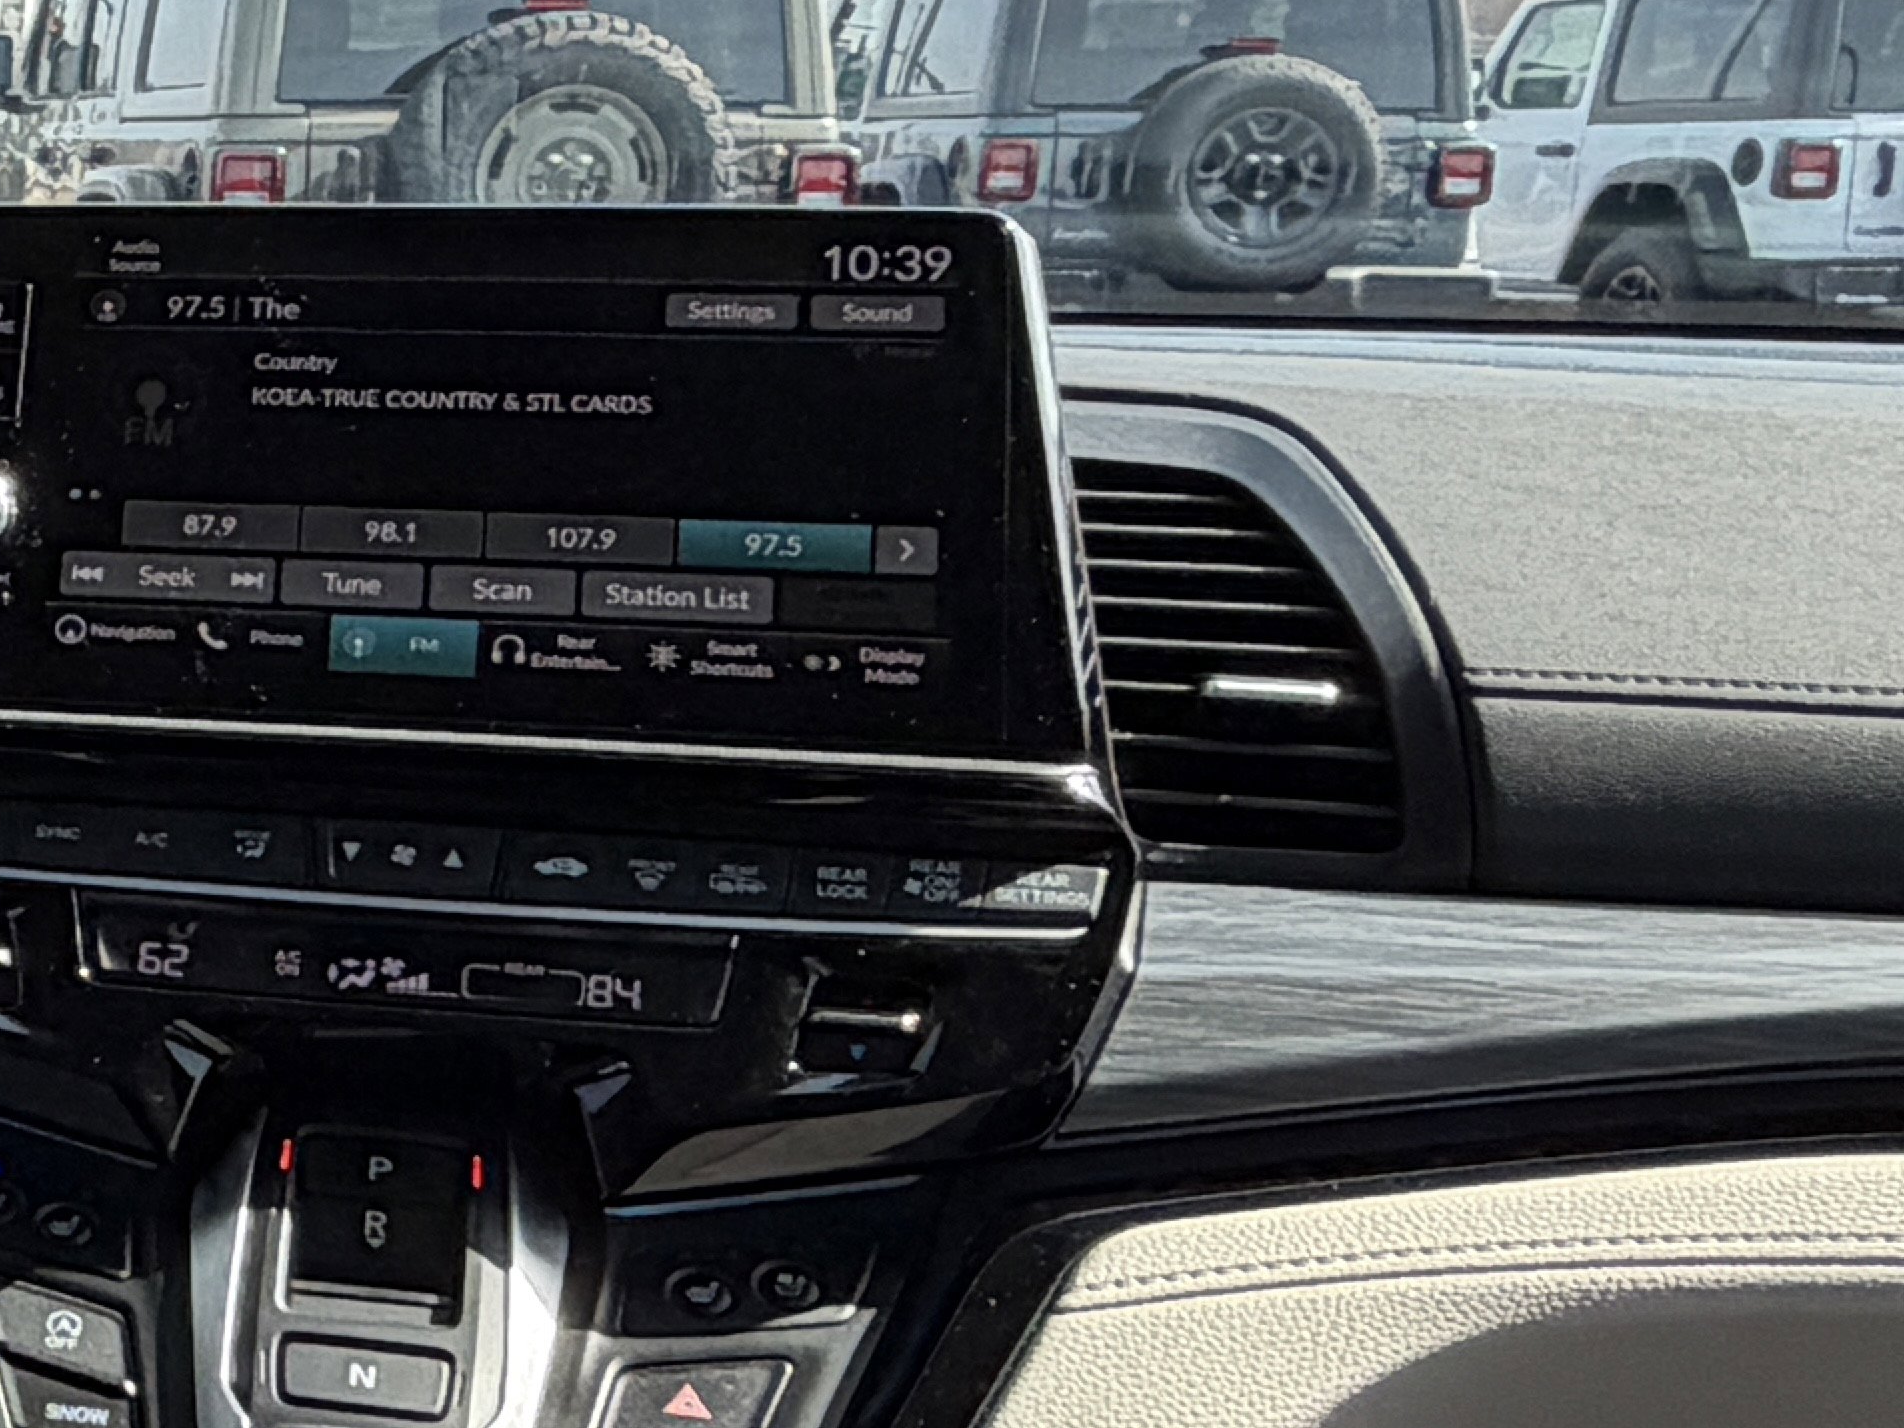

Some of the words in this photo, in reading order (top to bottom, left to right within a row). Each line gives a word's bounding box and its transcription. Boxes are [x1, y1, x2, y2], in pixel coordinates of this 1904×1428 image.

[824, 245, 952, 282] 10:39
[167, 296, 225, 320] 97.5
[248, 297, 302, 321] The
[687, 300, 776, 324] Settings
[842, 302, 914, 324] Sound
[254, 352, 338, 374] Country
[385, 390, 498, 411] COUNTRY
[502, 392, 520, 412] &
[525, 393, 566, 413] STL
[570, 395, 653, 415] CARDS
[124, 419, 174, 447] FM
[182, 514, 238, 538] 87.9
[364, 520, 418, 544] 98.1
[547, 526, 617, 550] 107.9
[744, 533, 803, 557] 97.5
[138, 565, 196, 588] Seek
[322, 572, 382, 596] Tune
[472, 577, 533, 602] Scan
[605, 584, 697, 608] Station
[704, 587, 750, 611] List
[91, 624, 176, 642] Navigation
[250, 630, 304, 647] Phone
[409, 638, 440, 653] FM
[706, 641, 758, 658] Smart
[858, 646, 926, 668] Display
[864, 668, 920, 687] Mode
[817, 882, 868, 900] LOCK
[137, 941, 190, 978] 62
[587, 974, 642, 1012] 84
[368, 1155, 394, 1182] P
[363, 1209, 388, 1240] R
[348, 1361, 378, 1390] N
[45, 1402, 110, 1427] SNOW
